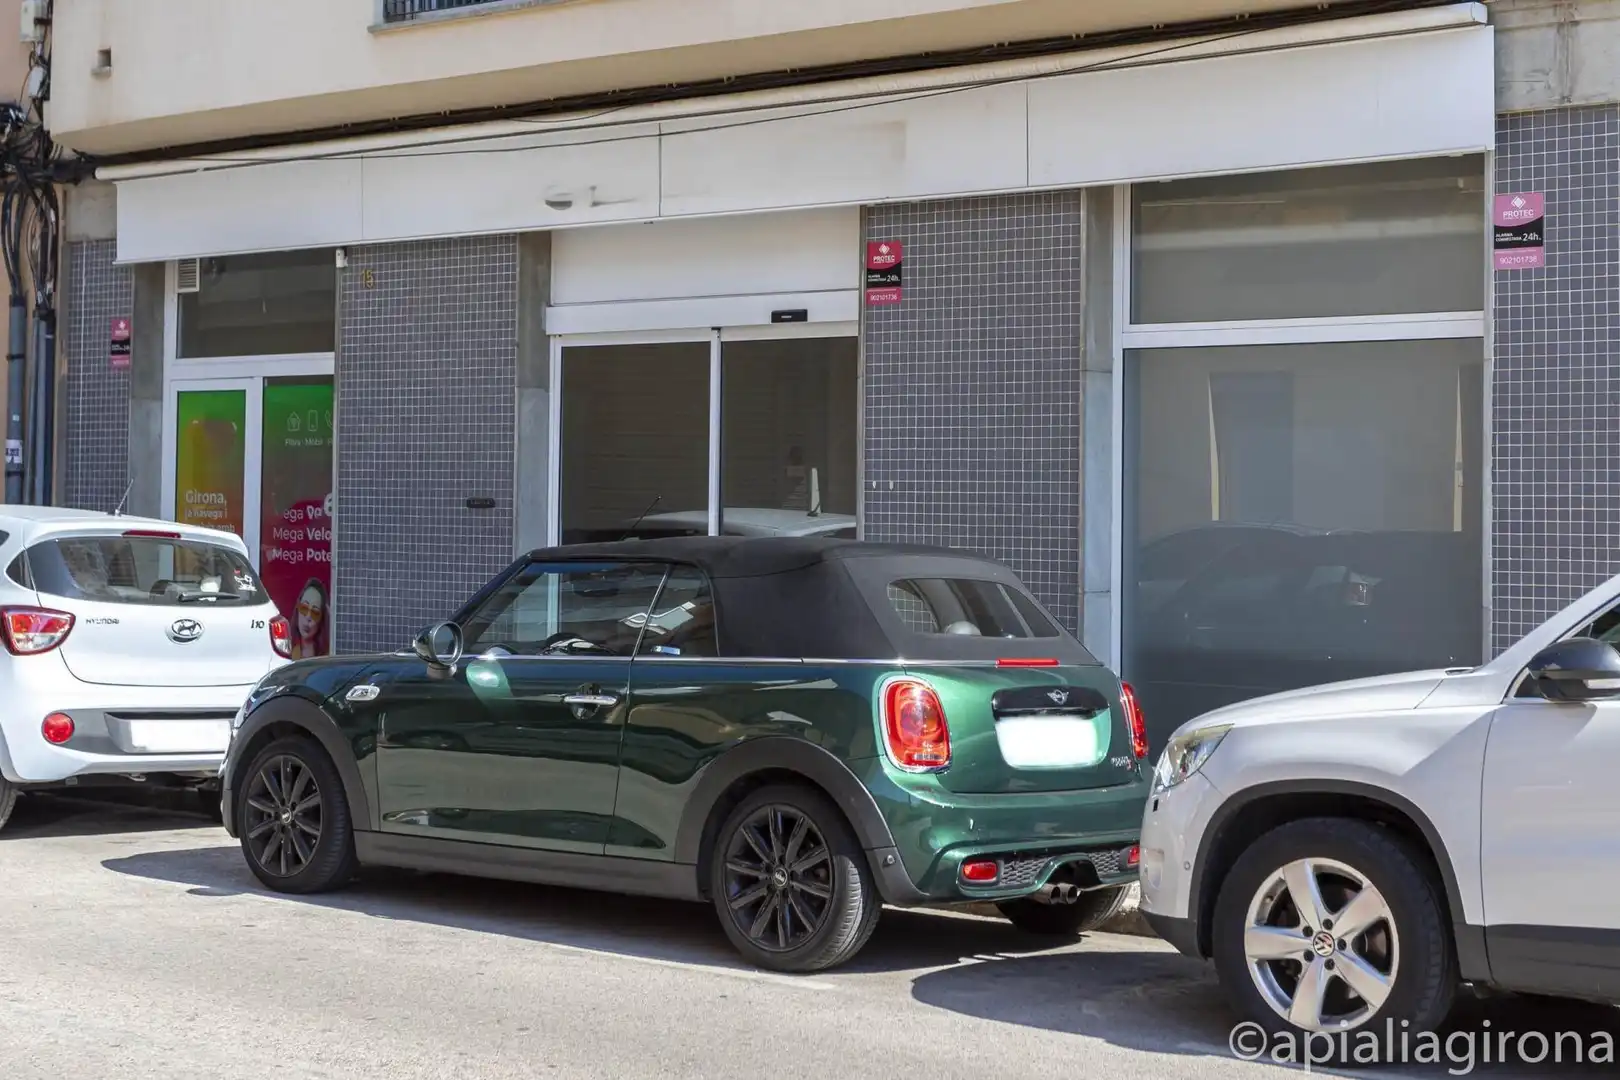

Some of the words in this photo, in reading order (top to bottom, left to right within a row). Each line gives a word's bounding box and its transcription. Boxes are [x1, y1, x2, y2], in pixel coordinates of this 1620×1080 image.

[1503, 209, 1534, 218] PROTEC
[873, 255, 895, 263] PROTEC
[272, 527, 304, 543] Mega
[272, 547, 304, 564] Mega
